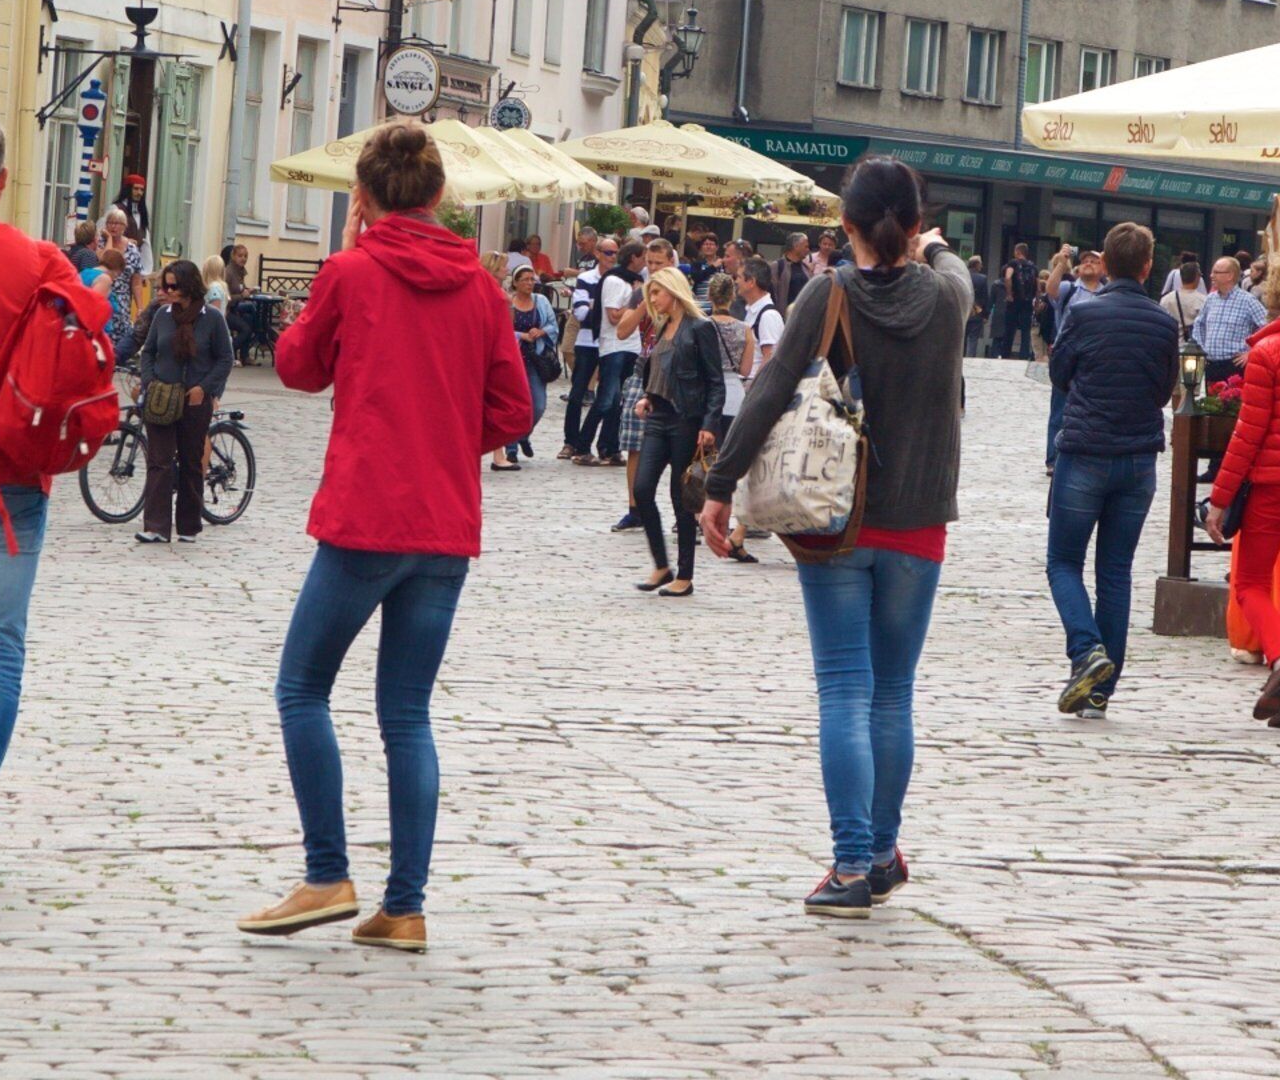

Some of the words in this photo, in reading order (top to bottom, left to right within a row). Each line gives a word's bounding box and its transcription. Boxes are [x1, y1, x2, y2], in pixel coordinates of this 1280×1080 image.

[386, 79, 434, 92] SANGLA
[1042, 114, 1074, 141] saku
[1127, 116, 1155, 144] saku
[1209, 115, 1238, 144] saku
[765, 139, 849, 158] RAAMATUD
[597, 162, 619, 172] saku
[651, 168, 674, 178] saku
[287, 170, 314, 183] saku
[706, 175, 729, 186] saku
